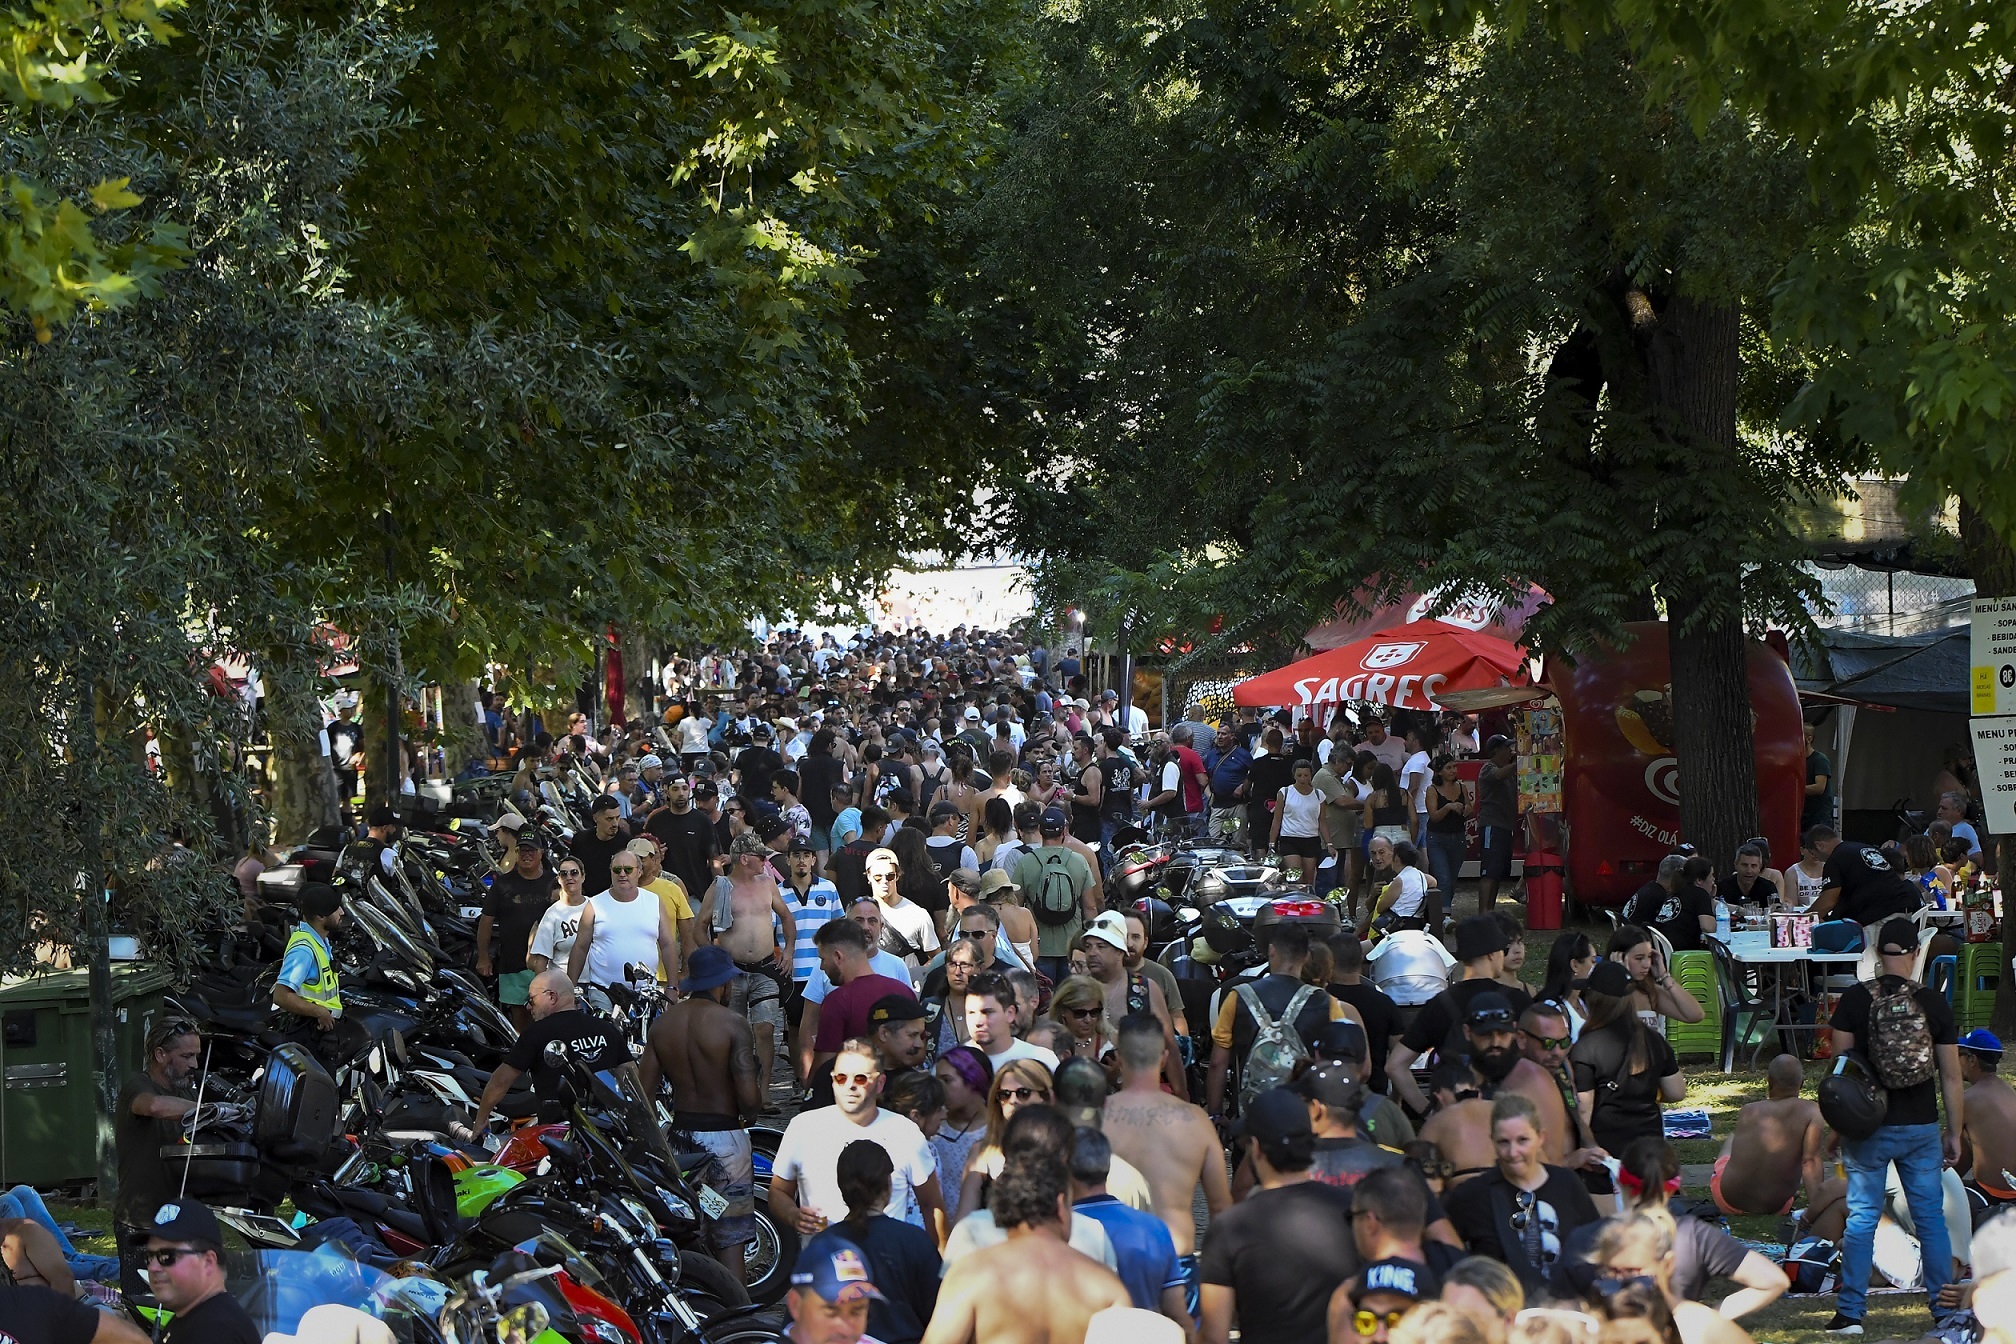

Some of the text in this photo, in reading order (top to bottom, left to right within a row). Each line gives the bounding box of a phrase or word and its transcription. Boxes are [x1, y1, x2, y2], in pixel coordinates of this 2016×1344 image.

[1975, 603, 1999, 613] MENU
[1293, 673, 1447, 711] SAGRES
[1977, 729, 2005, 739] MENU
[1629, 814, 1679, 847] #DIZ OLÁ
[570, 1034, 608, 1053] SILVA
